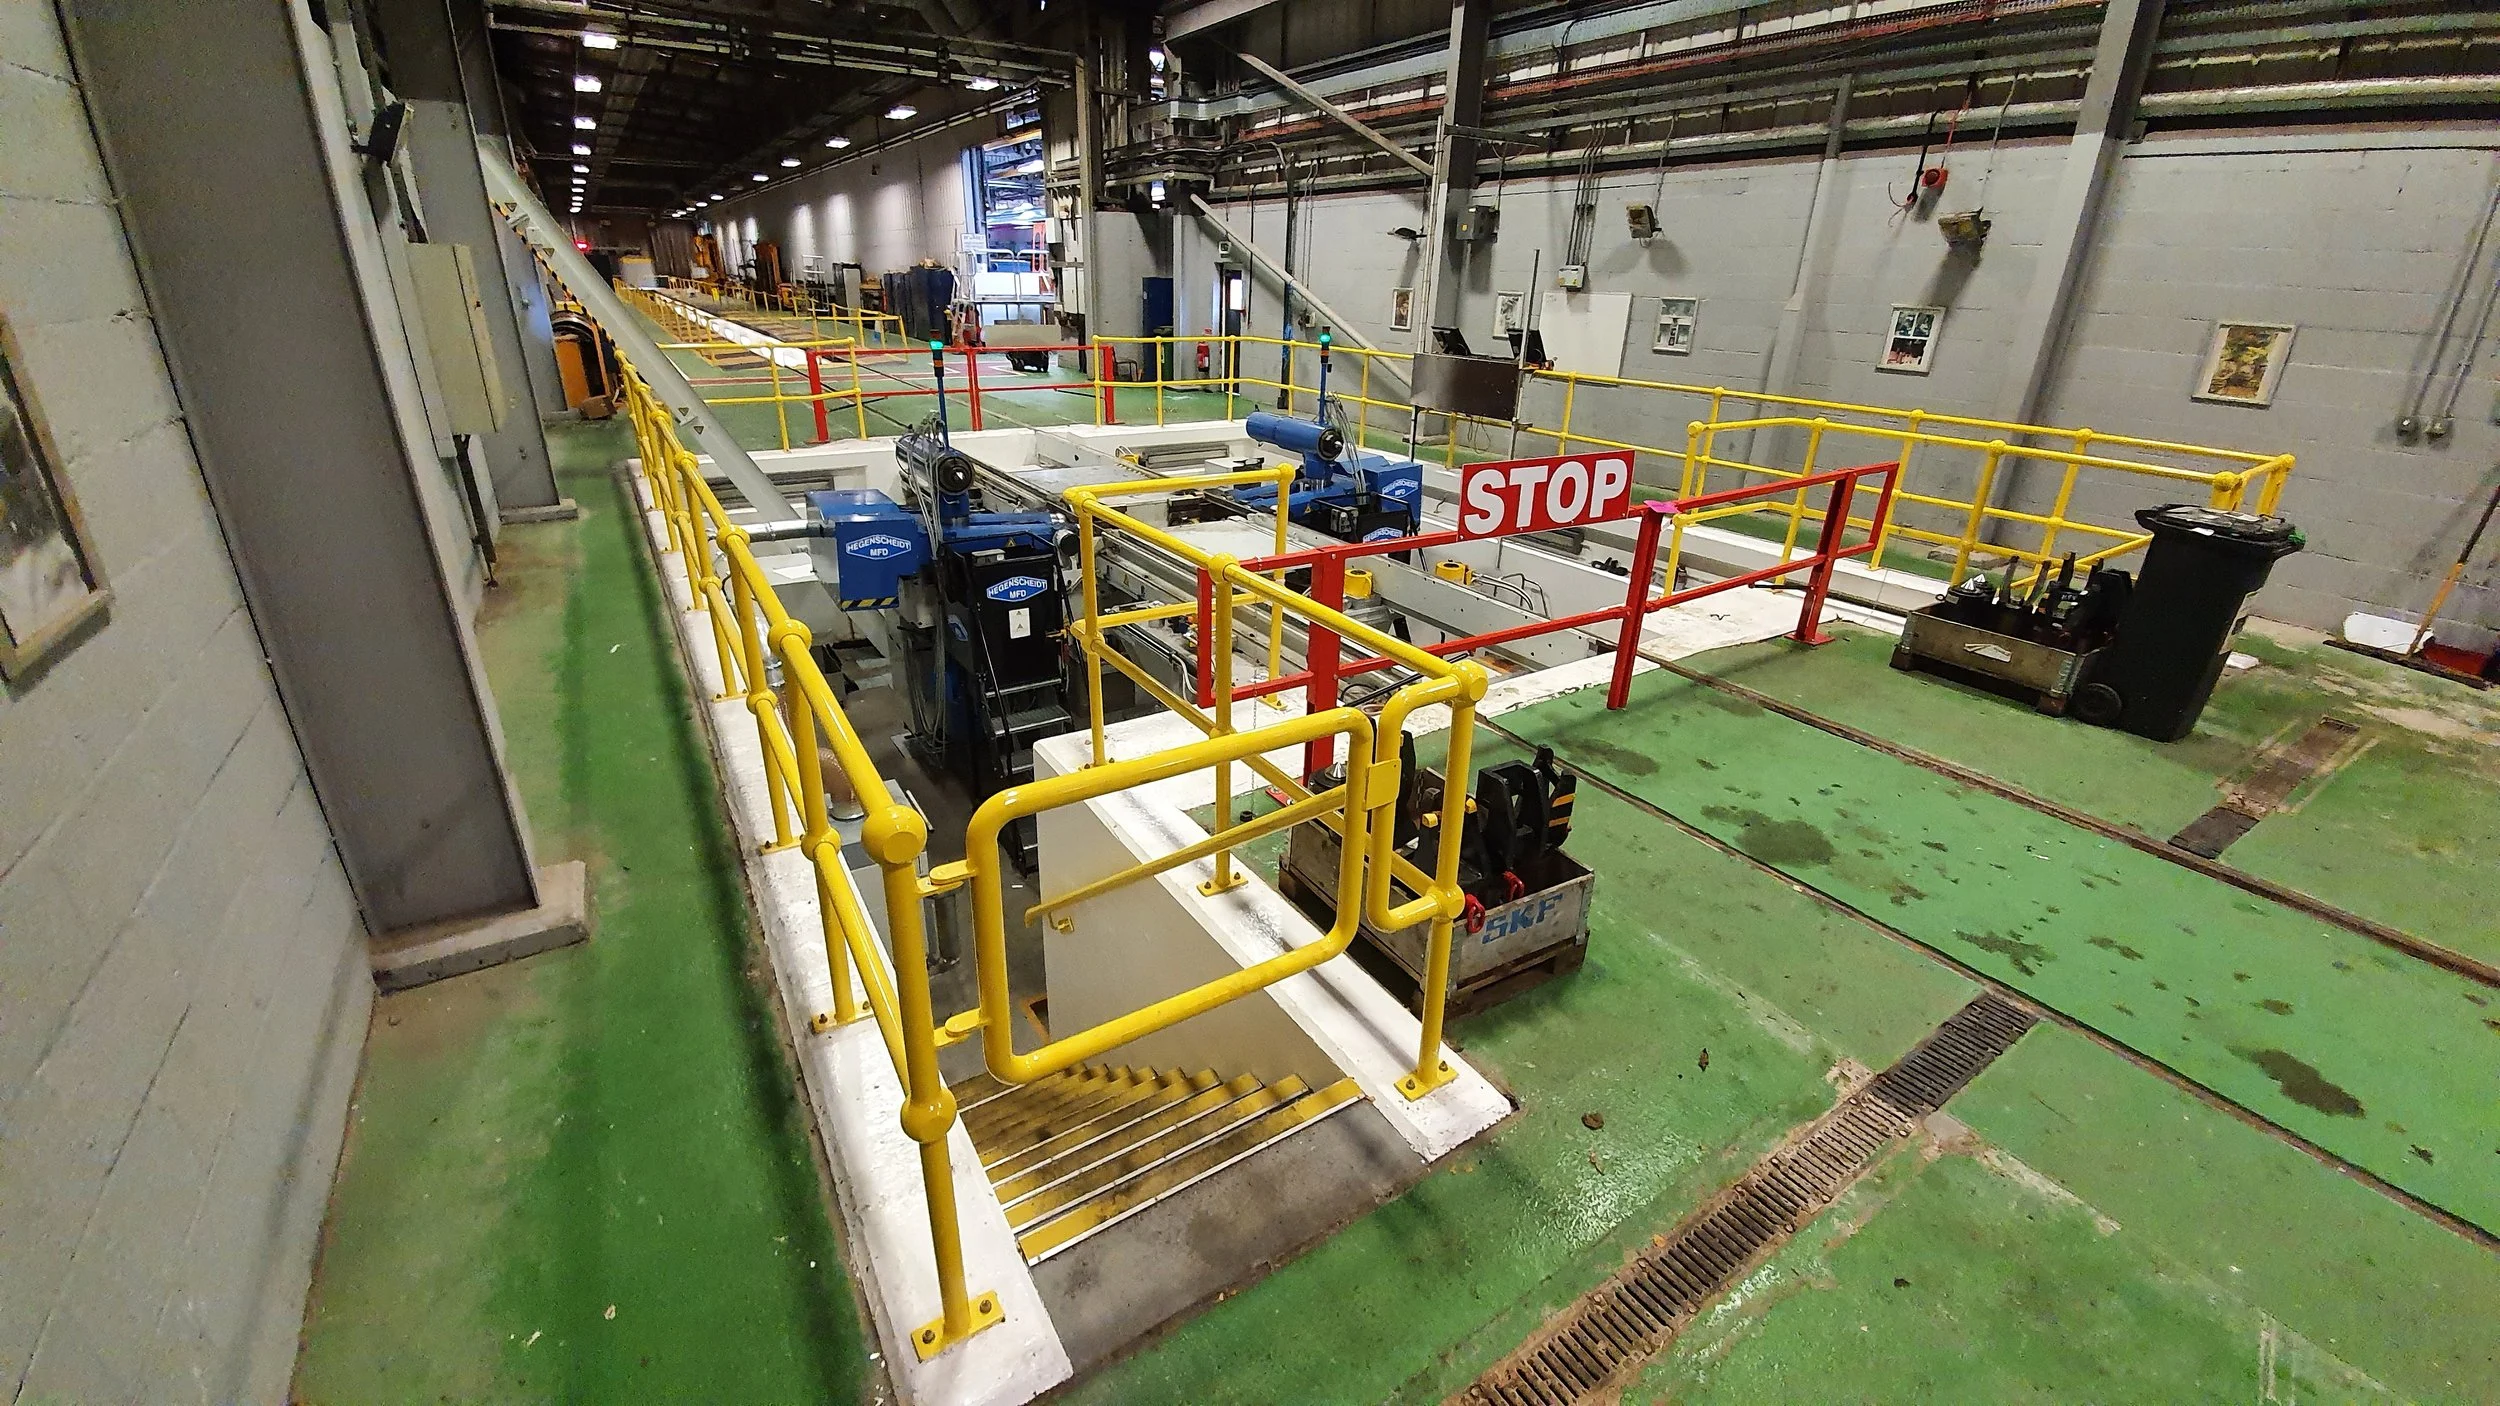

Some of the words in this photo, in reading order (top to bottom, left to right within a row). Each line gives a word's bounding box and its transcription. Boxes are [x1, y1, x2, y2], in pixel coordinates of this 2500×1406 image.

[1464, 458, 1628, 535] STOP
[847, 536, 909, 551] HEGENSCHEIDT
[870, 548, 889, 556] MFD
[988, 579, 1046, 597] HEGENSCHEIDT
[1009, 590, 1027, 599] MFD
[1482, 893, 1563, 944] SKF
